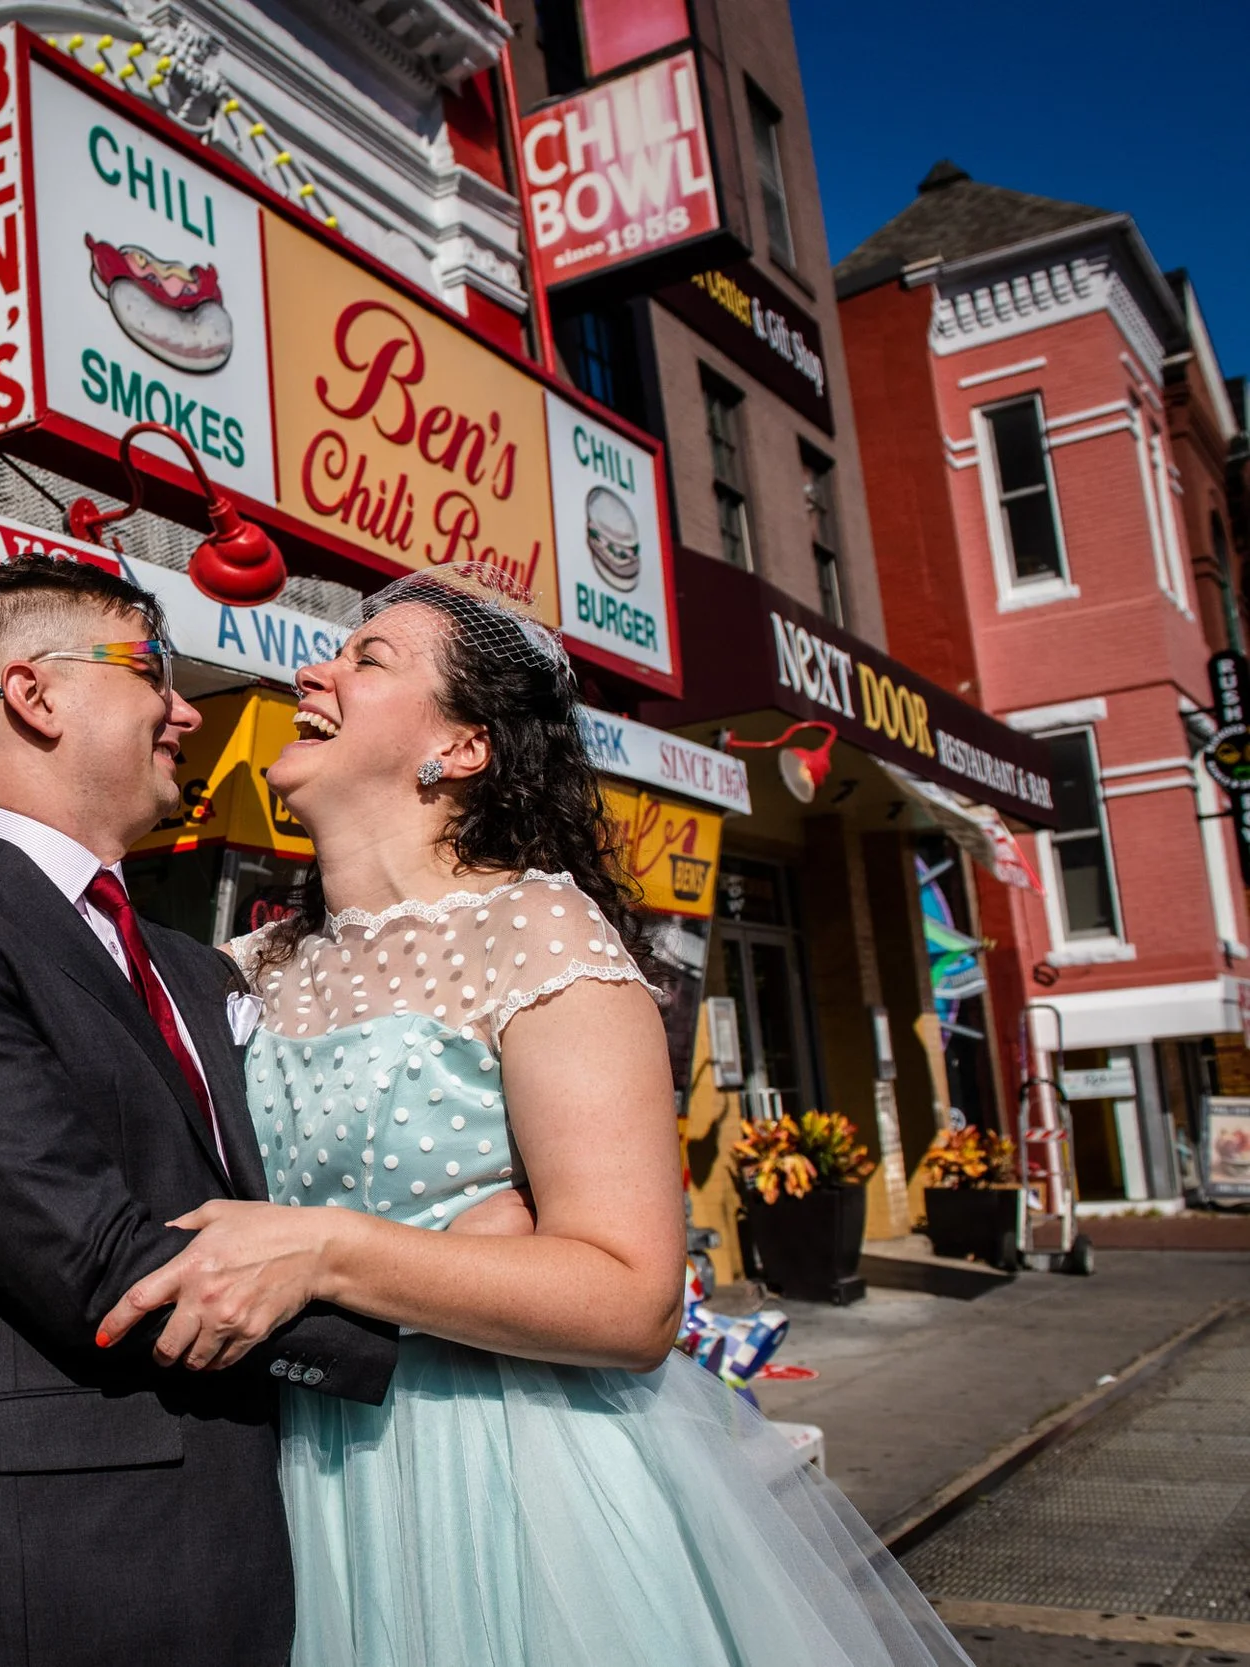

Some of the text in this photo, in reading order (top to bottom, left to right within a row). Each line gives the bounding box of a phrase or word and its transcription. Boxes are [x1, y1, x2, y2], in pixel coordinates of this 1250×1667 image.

[522, 66, 697, 188] CHILI
[87, 125, 217, 247] CHILI
[529, 137, 710, 249] BOWL
[553, 205, 691, 269] since 1958
[80, 348, 246, 469] SMOKES
[315, 299, 518, 501] Ben's
[765, 308, 794, 363] Gift
[790, 330, 825, 398] Shop
[301, 429, 414, 552] Chili
[572, 424, 637, 495] CHILI
[217, 602, 342, 670] A WAS
[575, 582, 659, 653] BURGER
[659, 740, 715, 792] SINCE
[856, 661, 936, 759] DOOR
[935, 728, 1018, 797] RESTAURANT
[1028, 770, 1054, 810] BAR
